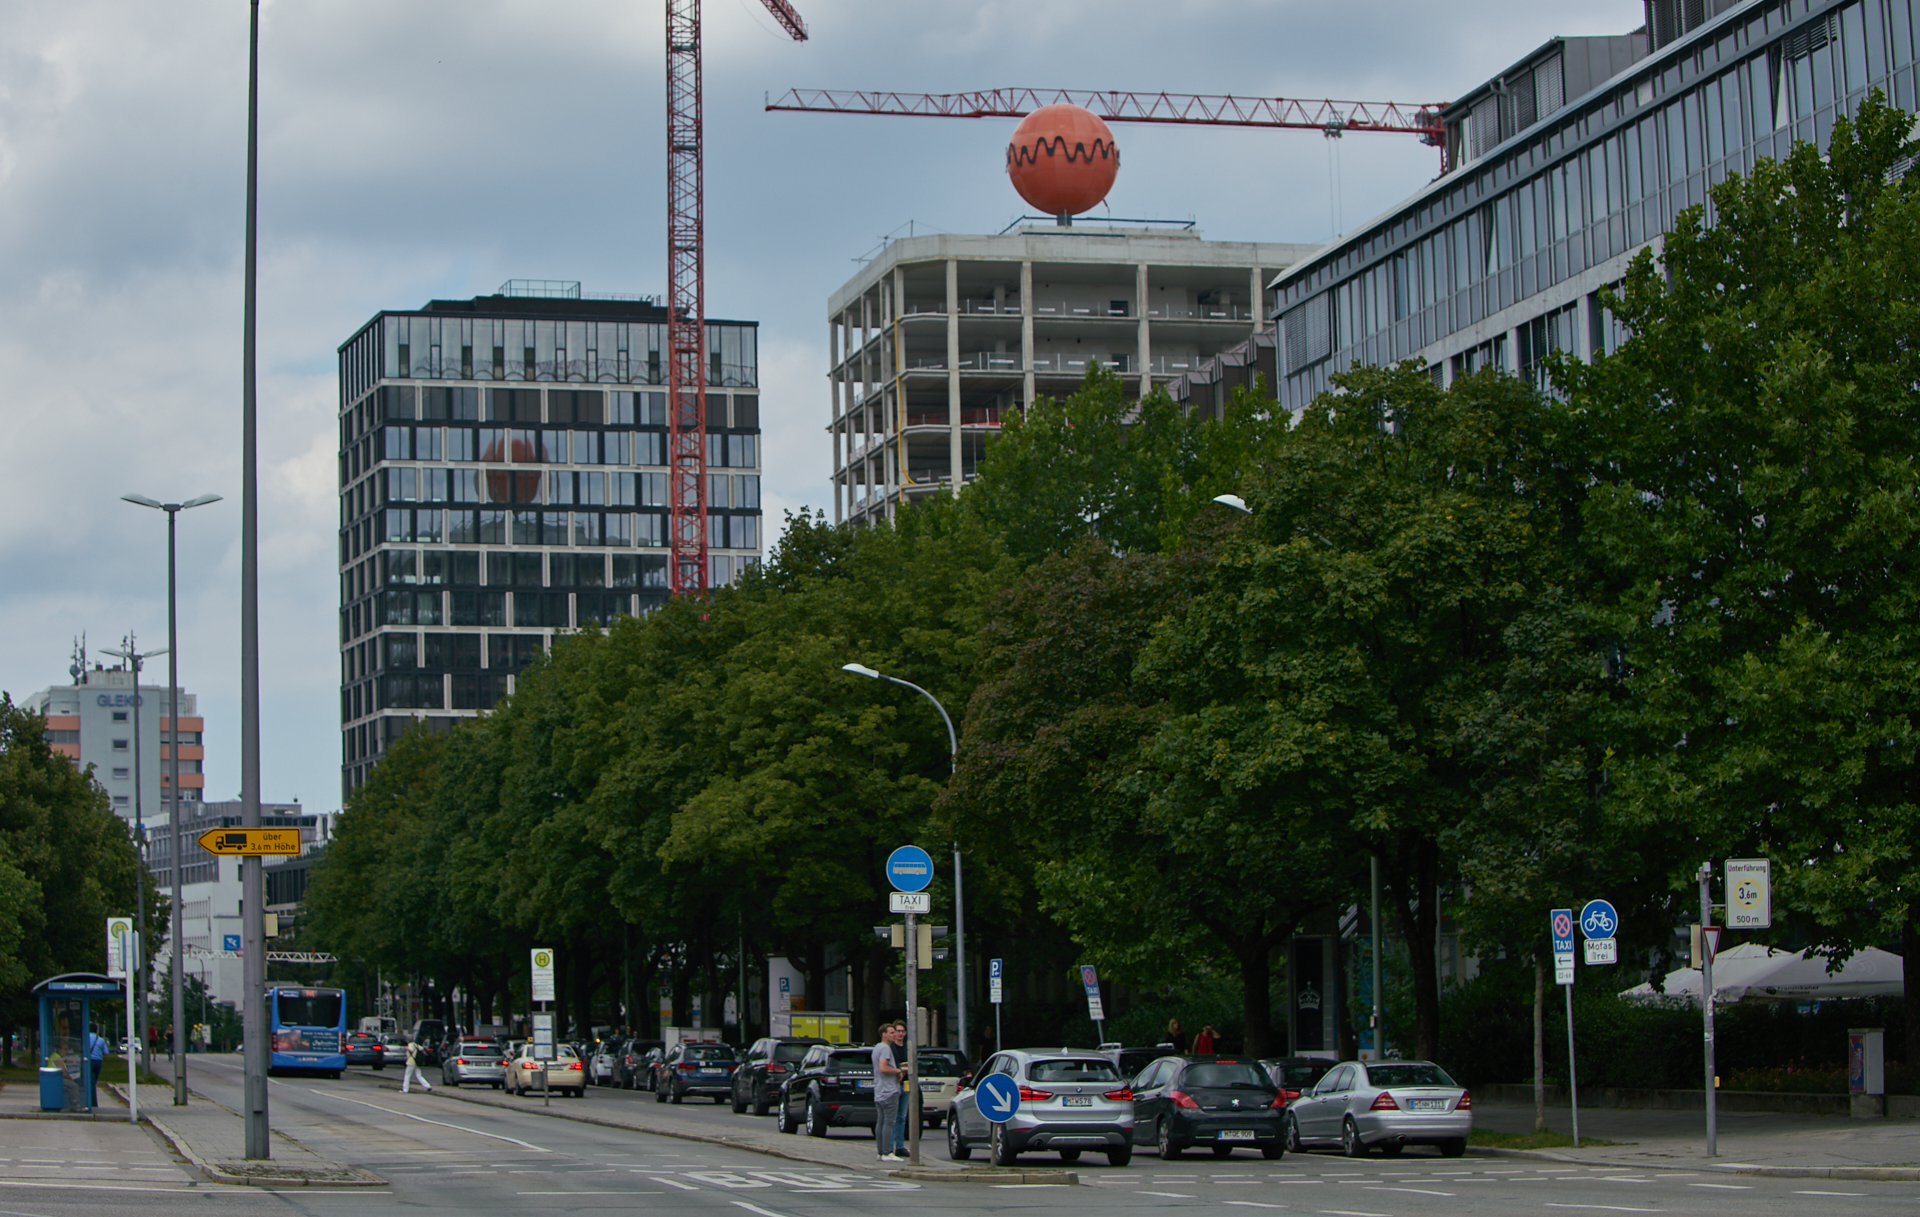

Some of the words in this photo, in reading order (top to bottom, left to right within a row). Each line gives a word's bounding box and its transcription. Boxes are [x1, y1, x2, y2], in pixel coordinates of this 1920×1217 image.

[263, 833, 282, 841] über
[274, 843, 296, 851] Höhe
[1728, 864, 1767, 873] Unterführung
[900, 896, 921, 905] TAXI
[1736, 915, 1751, 923] 500
[1555, 940, 1572, 951] TAXI
[1588, 942, 1612, 951] Mofas
[679, 1171, 921, 1189] BUS
